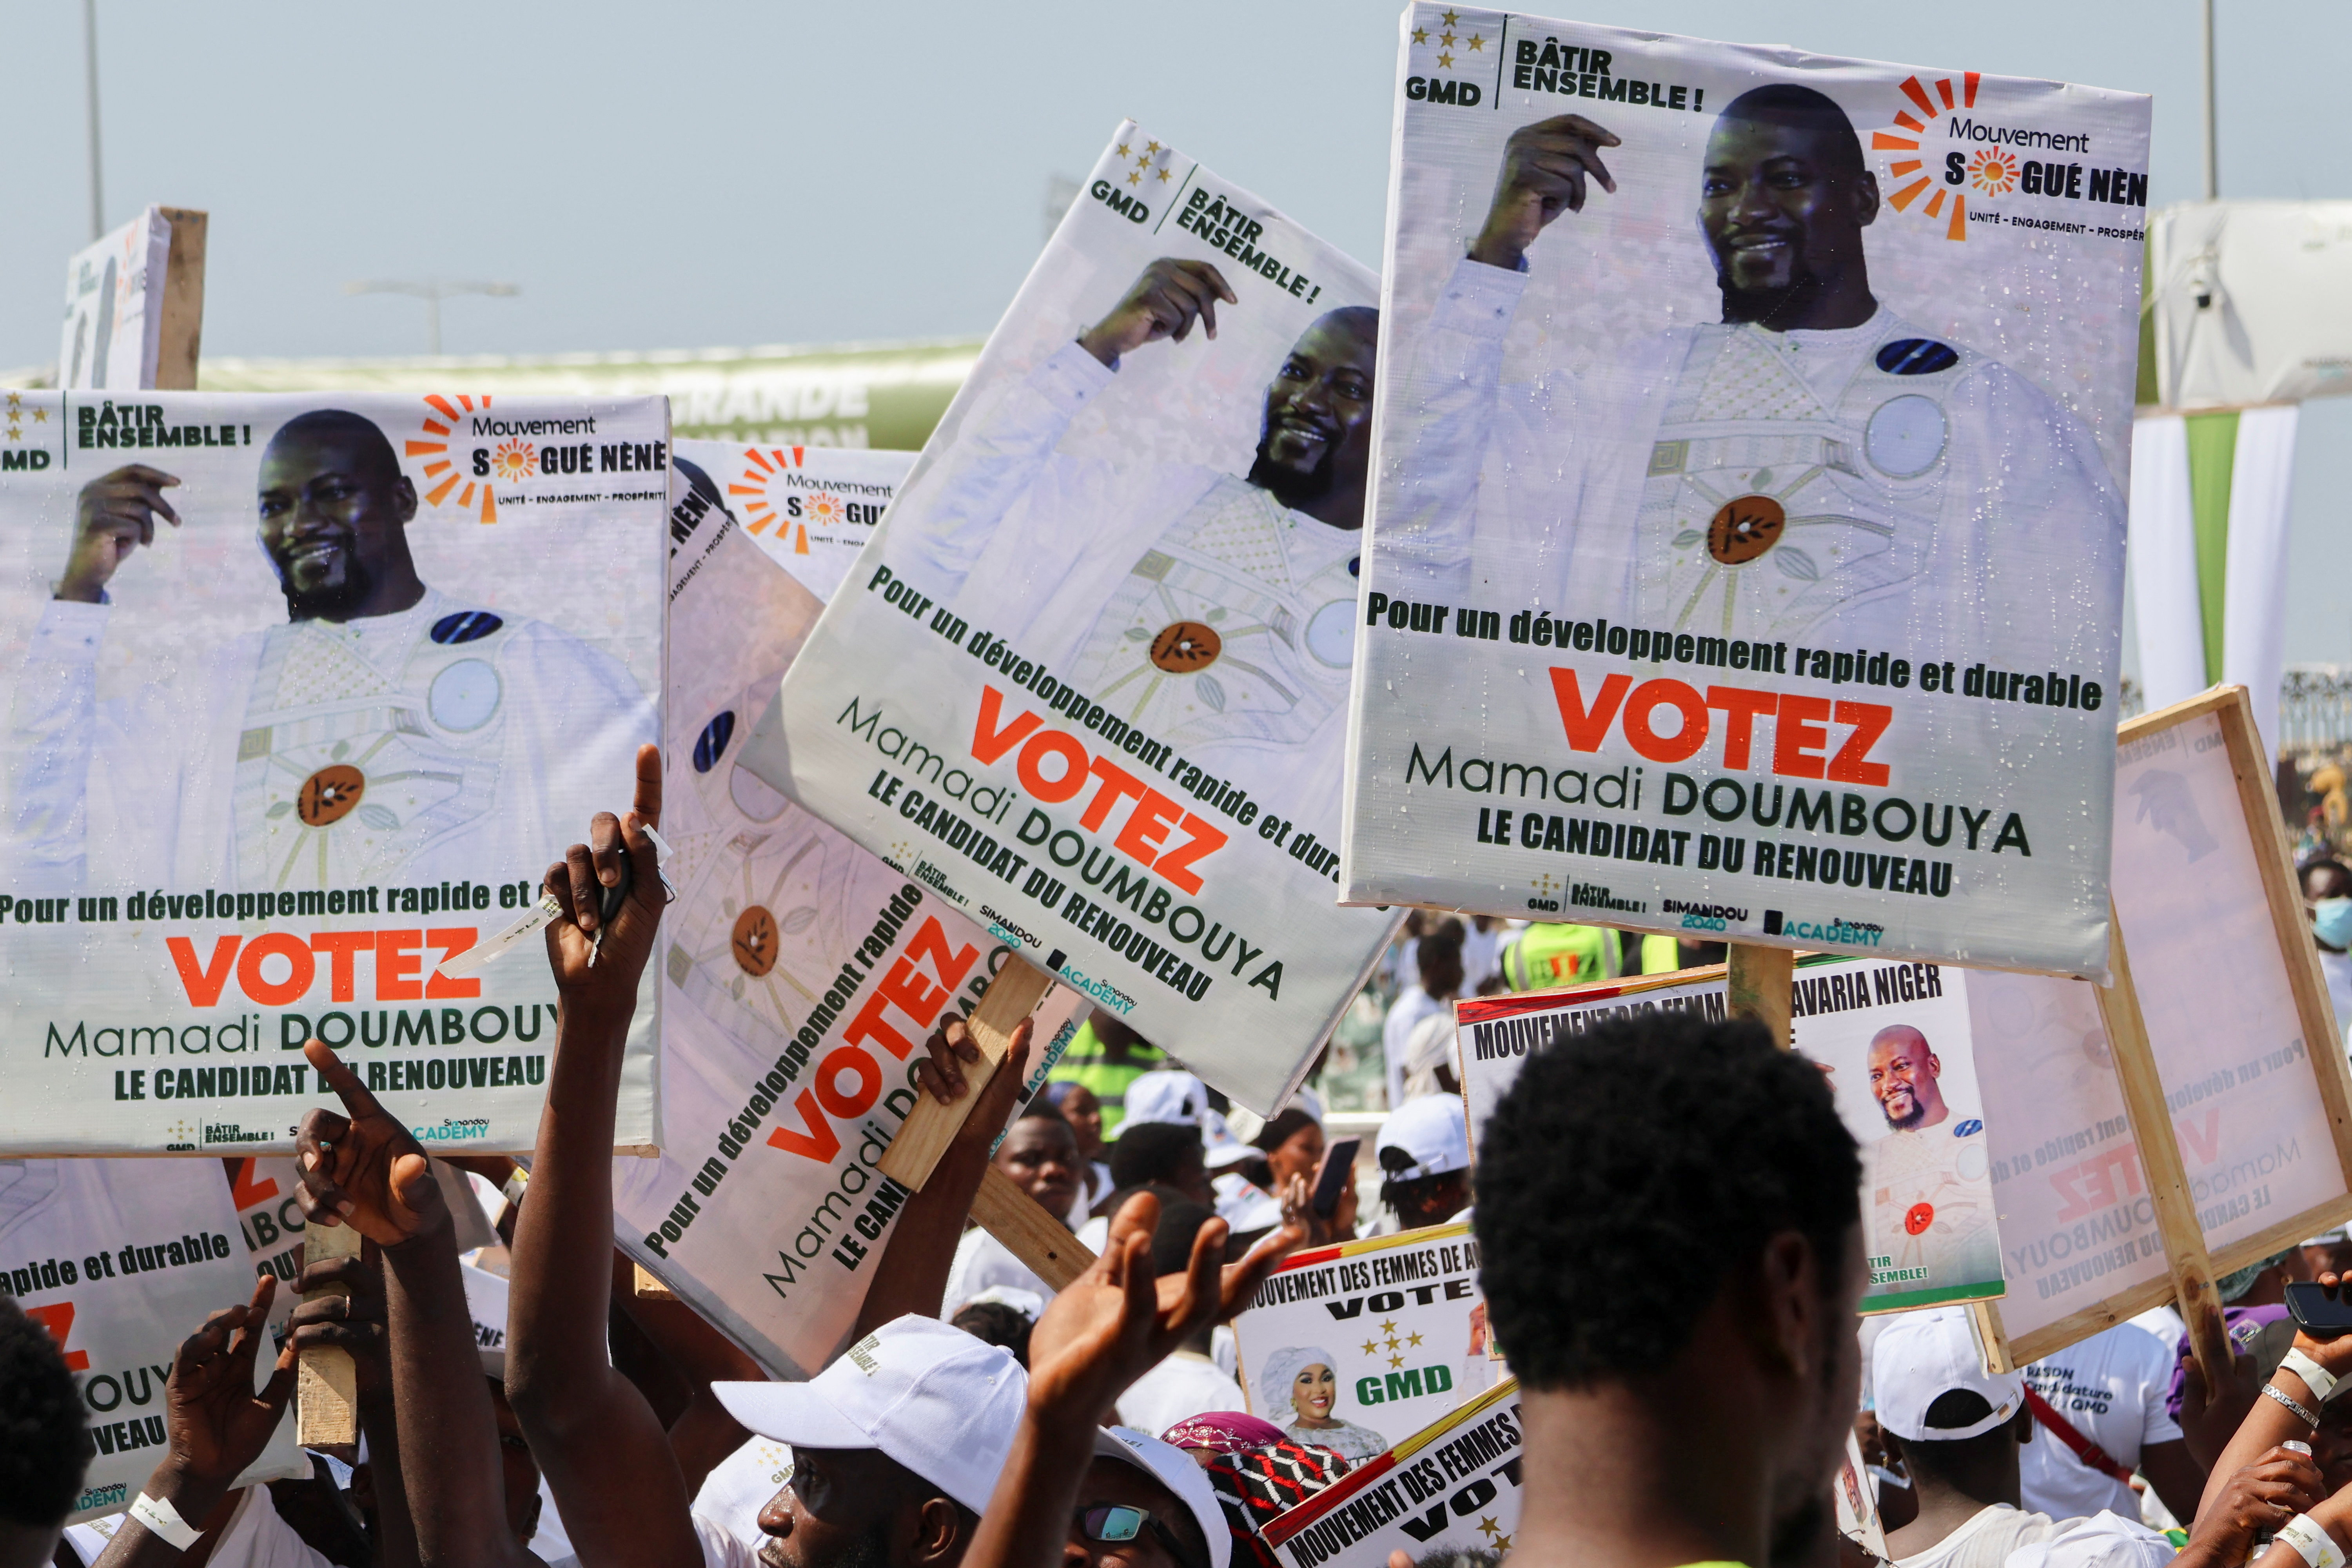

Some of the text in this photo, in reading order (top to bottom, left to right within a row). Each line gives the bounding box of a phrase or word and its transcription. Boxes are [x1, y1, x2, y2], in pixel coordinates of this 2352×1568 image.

[1516, 37, 1612, 76] BÂTIR
[1405, 76, 1481, 106] GMD
[1949, 117, 2089, 154] Mouvement
[1091, 180, 1150, 224] GMD
[1188, 187, 1263, 245] BÂTIR
[1969, 212, 2000, 224] UNITÉ
[2012, 216, 2085, 234] ENGAGEMENT
[78, 400, 165, 428] BÂTIR
[472, 416, 596, 436] Mouvement
[601, 441, 666, 472] NÈNÈ
[499, 495, 526, 506] UNITÉ
[537, 493, 602, 505] ENGAGEMENT
[788, 473, 893, 498] Mouvement
[672, 485, 712, 545] NÈN
[811, 535, 834, 544] UNITÉ
[1367, 592, 2102, 711] Pour un développement rapide et durable
[867, 564, 934, 621] Pour
[930, 606, 969, 645] un
[967, 631, 1173, 773] développement
[1168, 755, 1258, 826] rapide
[1258, 814, 1292, 848] et
[1548, 666, 1892, 787] VOTEZ
[971, 684, 1229, 897] VOTEZ
[1406, 742, 2032, 857] Mamadi DOUMBOUYA
[837, 695, 1017, 826] Mamadi
[1016, 808, 1284, 1001] DOUMBOUYA
[1477, 808, 1952, 898] LE CANDIDAT DU RENOUVEAU
[868, 769, 904, 807] LE
[900, 790, 1029, 884] CANDIDAT
[1022, 868, 1067, 909] DU
[1061, 893, 1213, 1002] RENOUVEAU
[918, 860, 947, 882] BÂTIR
[0, 894, 69, 924] Pour
[78, 895, 118, 922] un
[127, 885, 379, 921] développement
[387, 881, 490, 915] rapide
[499, 880, 530, 909] et
[1662, 899, 1749, 922] SIMANDOU
[1682, 914, 1726, 932] 2040
[980, 905, 1042, 948] SIMANDOU
[988, 923, 1021, 949] 2040
[1782, 920, 1882, 947] ACADEMY
[166, 927, 481, 1007] VOTEZ
[1873, 963, 1942, 1005] NIGER
[1060, 965, 1134, 1015] ACADEMY
[45, 1004, 558, 1058] Mamadi DOUMBOU
[767, 916, 980, 1164] VOTEZ
[115, 1071, 145, 1100] LE
[154, 1064, 309, 1099] CANDIDAT
[368, 1055, 544, 1092] RENOUVEAU
[644, 883, 924, 1259] Pour un développement rapide
[1028, 1022, 1077, 1093] ACADEMY
[205, 1123, 240, 1135] BÂTIR
[763, 1121, 892, 1298] Mamadi
[83, 1250, 115, 1281] et
[119, 1232, 230, 1274] durable
[832, 1233, 868, 1272] LE
[1247, 1267, 1336, 1310] OUVEMENT
[1341, 1261, 1370, 1292] DES
[1373, 1249, 1437, 1286] FEMMES
[1440, 1245, 1462, 1274] DE
[1325, 1278, 1474, 1321] VOTE
[1356, 1365, 1453, 1406] GMD
[1286, 1412, 1522, 1568] MOUVEMENT DES FEMMES
